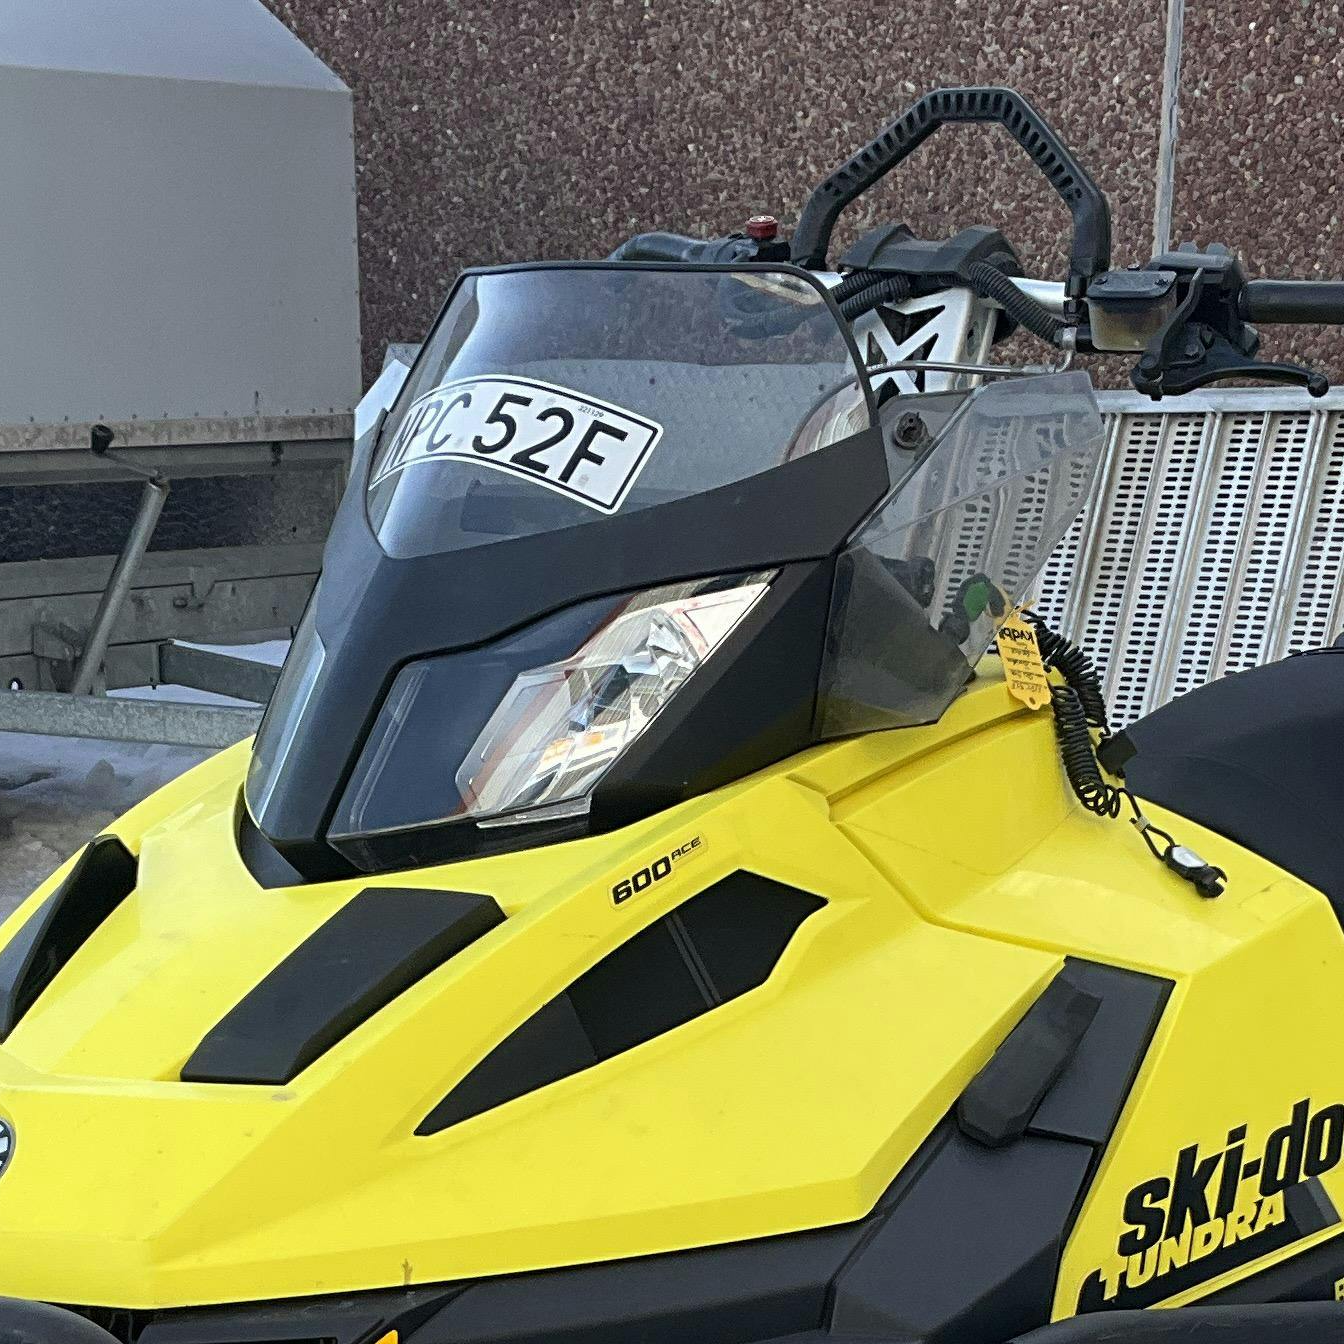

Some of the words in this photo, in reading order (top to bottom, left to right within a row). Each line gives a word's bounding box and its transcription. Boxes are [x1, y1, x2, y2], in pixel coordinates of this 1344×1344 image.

[472, 392, 628, 484] 52F
[612, 854, 672, 905] 600
[671, 836, 702, 861] ACE
[1099, 1193, 1286, 1301] TUNDRA
